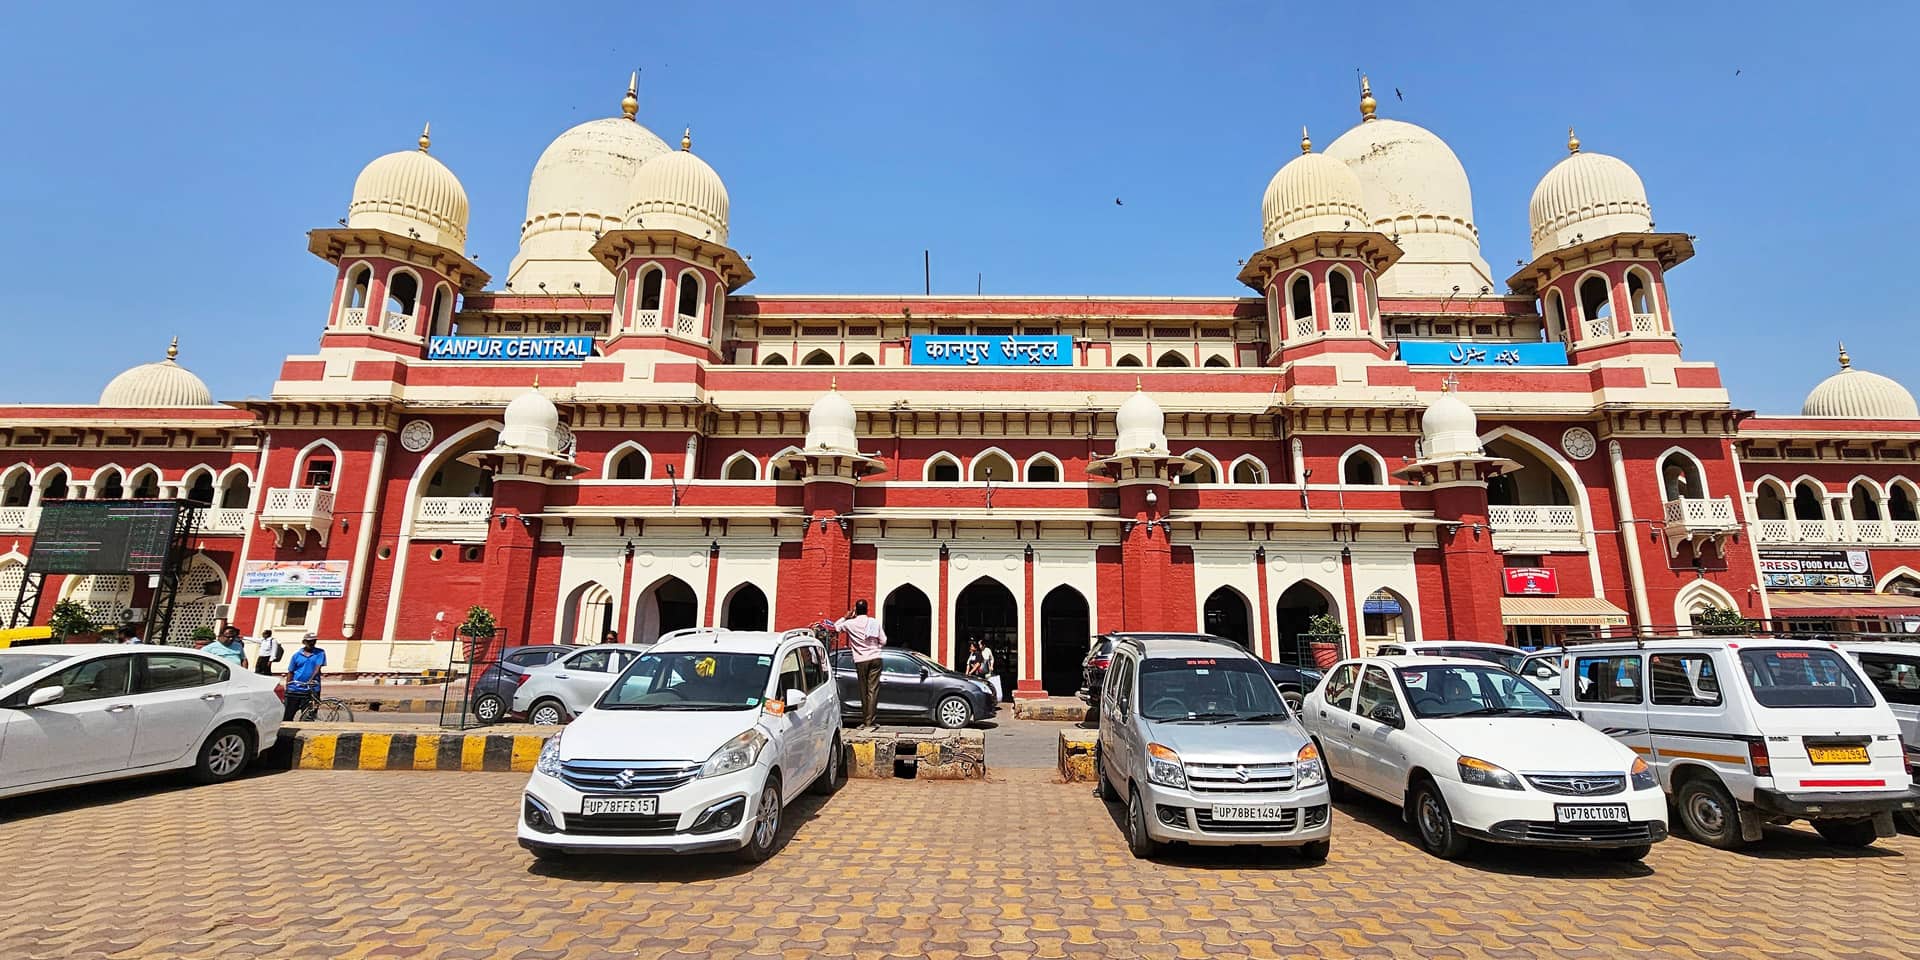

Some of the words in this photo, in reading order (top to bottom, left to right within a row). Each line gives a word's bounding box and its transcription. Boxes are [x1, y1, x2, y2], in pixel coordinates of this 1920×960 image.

[429, 339, 501, 356] KANPUR
[506, 339, 588, 356] CENTRAL
[925, 340, 990, 363] कानपुर
[1000, 335, 1058, 361] सेन्ट्रल
[1801, 560, 1822, 569] FOOD
[1824, 560, 1849, 569] PLAZA
[1219, 807, 1280, 818] UP78BE1494
[1564, 807, 1627, 819] UP78CT0878
